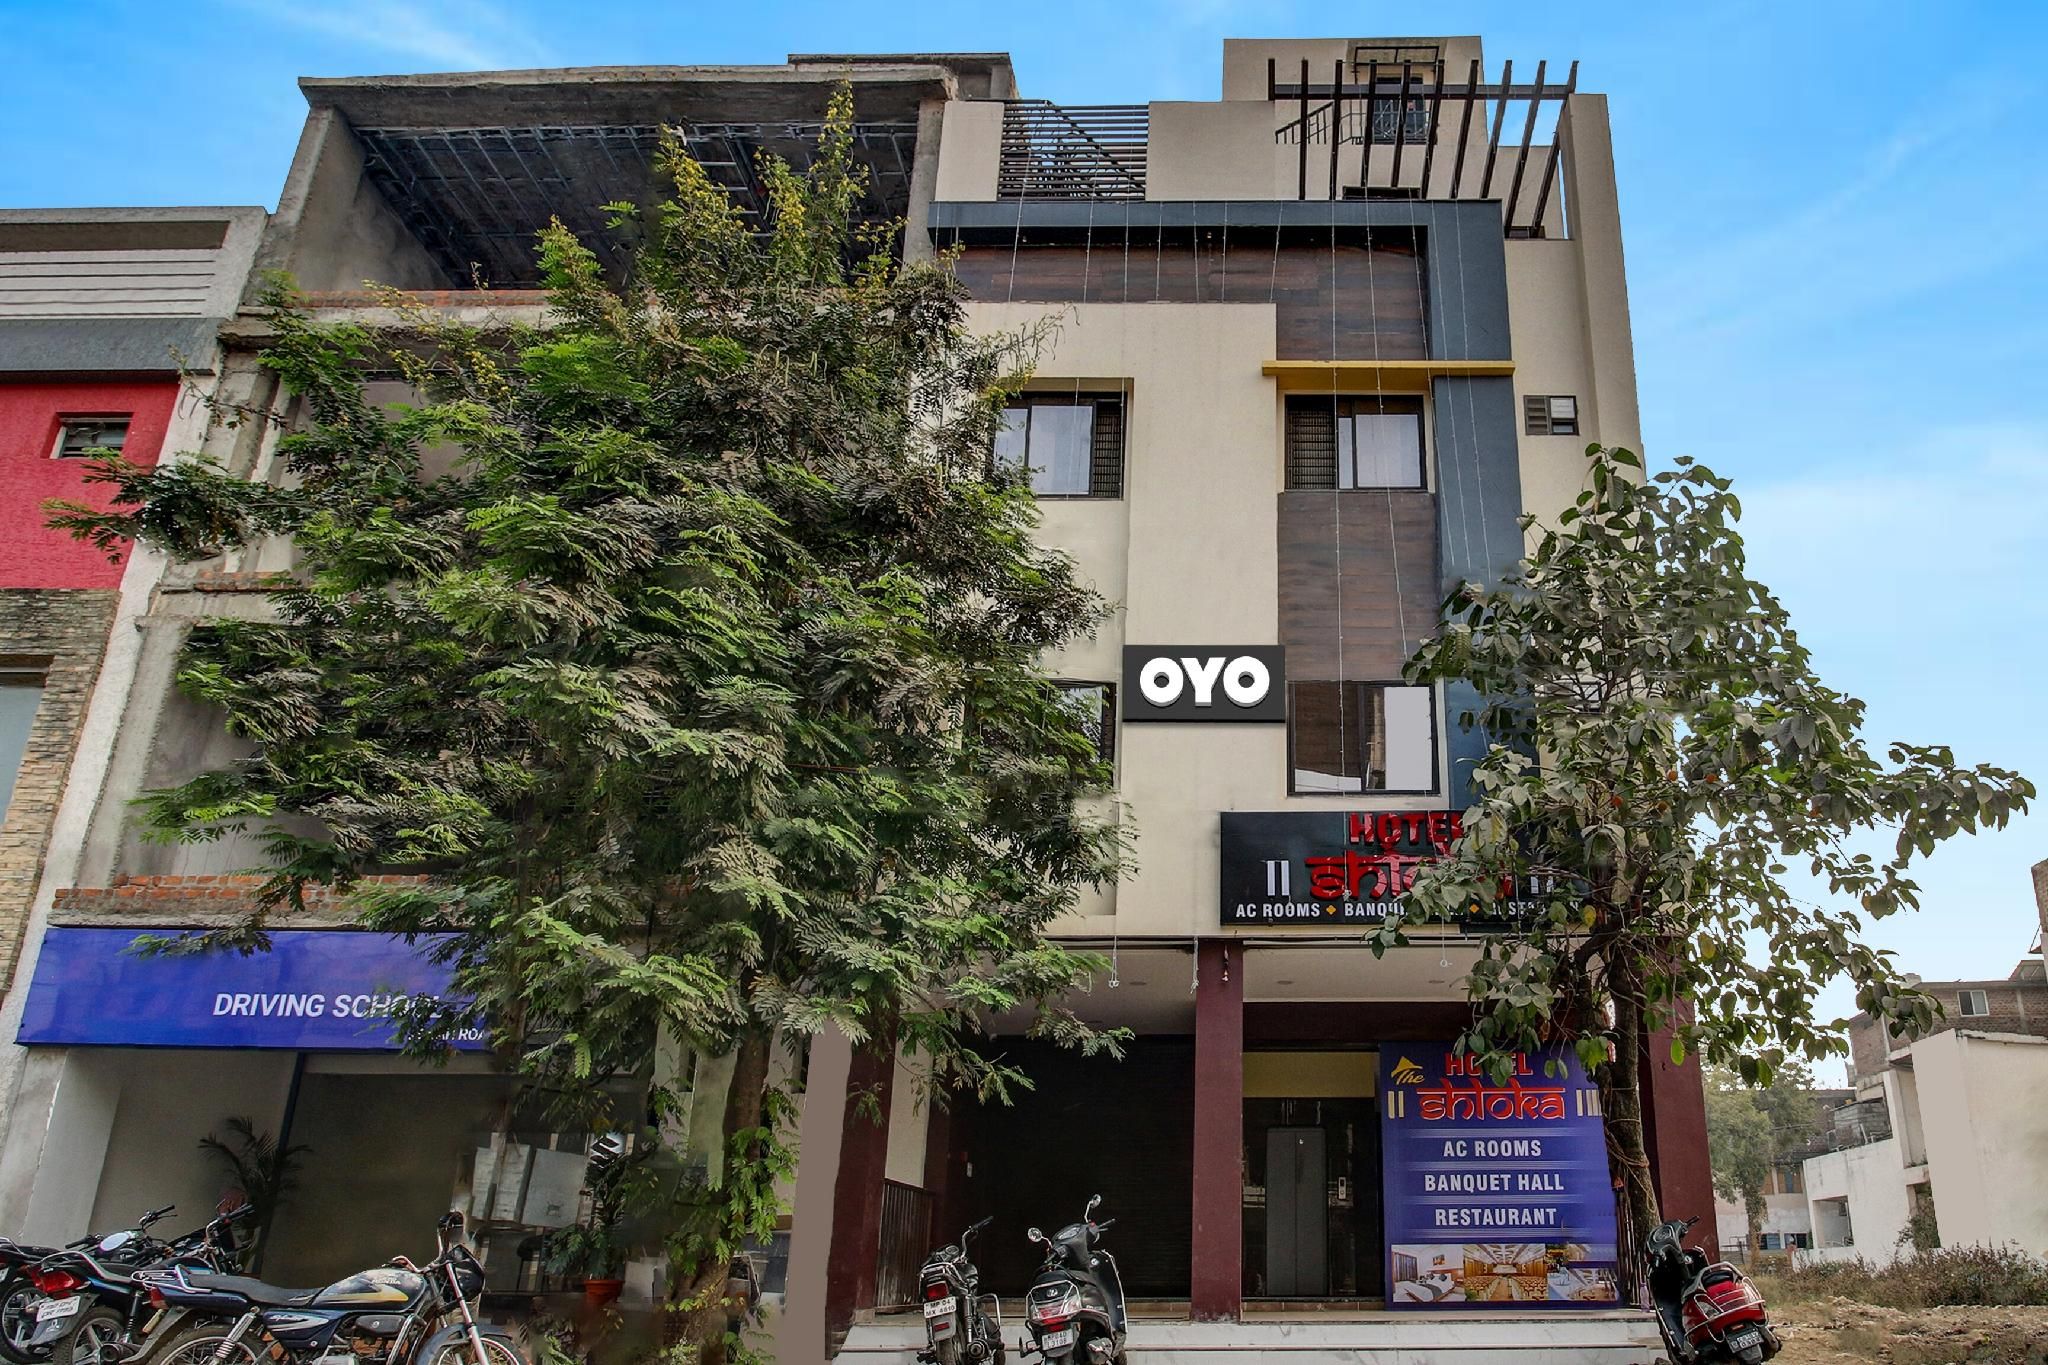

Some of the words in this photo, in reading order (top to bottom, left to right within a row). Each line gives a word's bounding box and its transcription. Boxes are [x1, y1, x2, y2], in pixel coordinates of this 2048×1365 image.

[1140, 656, 1270, 708] OYO
[1235, 903, 1257, 918] AC
[1262, 902, 1321, 918] ROOMS
[1344, 902, 1406, 918] BANQU
[213, 993, 325, 1018] DRIVING
[332, 994, 443, 1018] SCHO
[1445, 1052, 1534, 1076] HOL
[1395, 1069, 1425, 1086] The
[1443, 1140, 1467, 1157] AC
[1475, 1140, 1542, 1157] ROOMS
[1425, 1174, 1511, 1193] BANQUET
[1518, 1174, 1565, 1191] HALL
[1435, 1208, 1557, 1226] RESTAURANT
